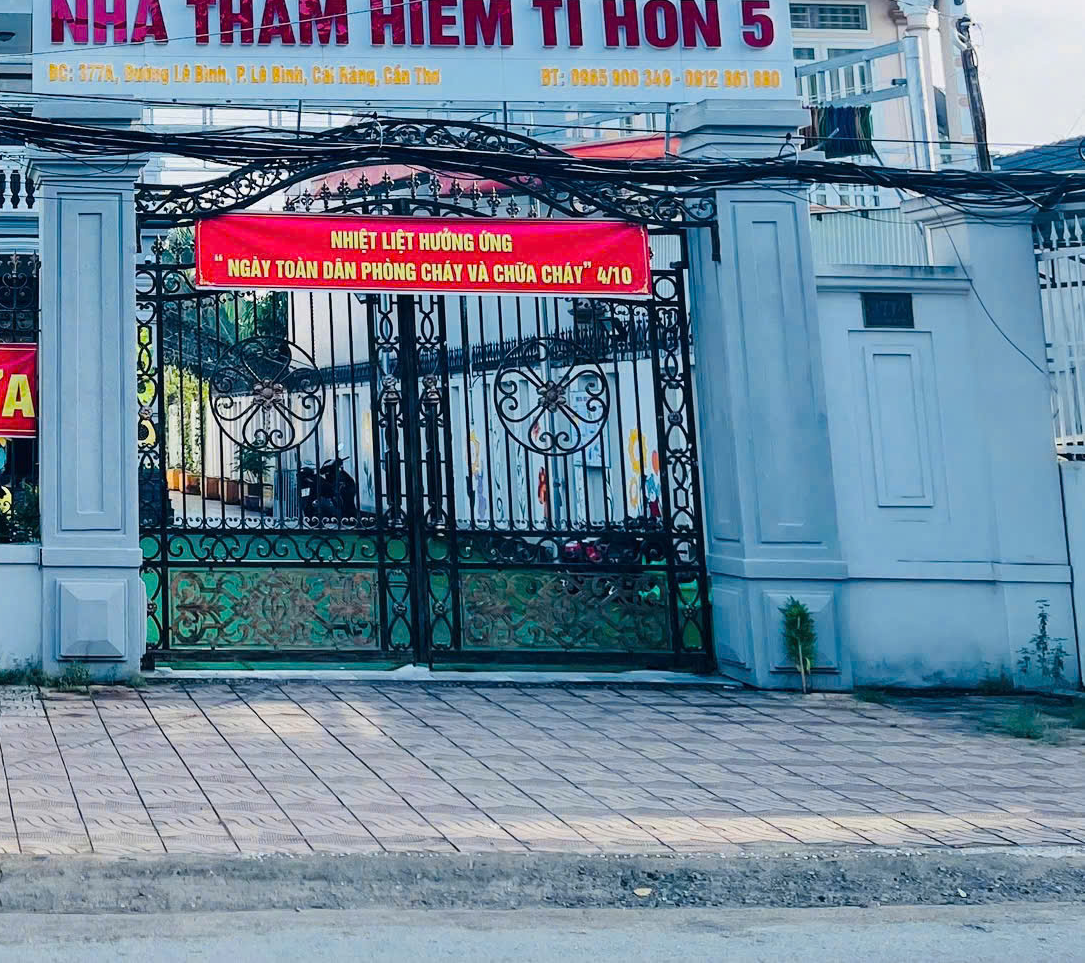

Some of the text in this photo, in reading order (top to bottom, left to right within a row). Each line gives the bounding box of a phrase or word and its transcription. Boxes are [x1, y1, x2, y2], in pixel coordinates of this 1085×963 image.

[741, 0, 775, 49] 5
[330, 228, 513, 254] NHIỆT LIỆT HƯỞNG ỨNG
[227, 255, 272, 278] NGÀY
[275, 256, 319, 279] TOÀN
[322, 258, 357, 280] DÂN
[361, 258, 417, 282] PHÒNG
[420, 260, 464, 282] CHÁY
[467, 261, 490, 283] VÀ
[493, 261, 538, 284] CHỮA
[596, 266, 633, 286] 4/10
